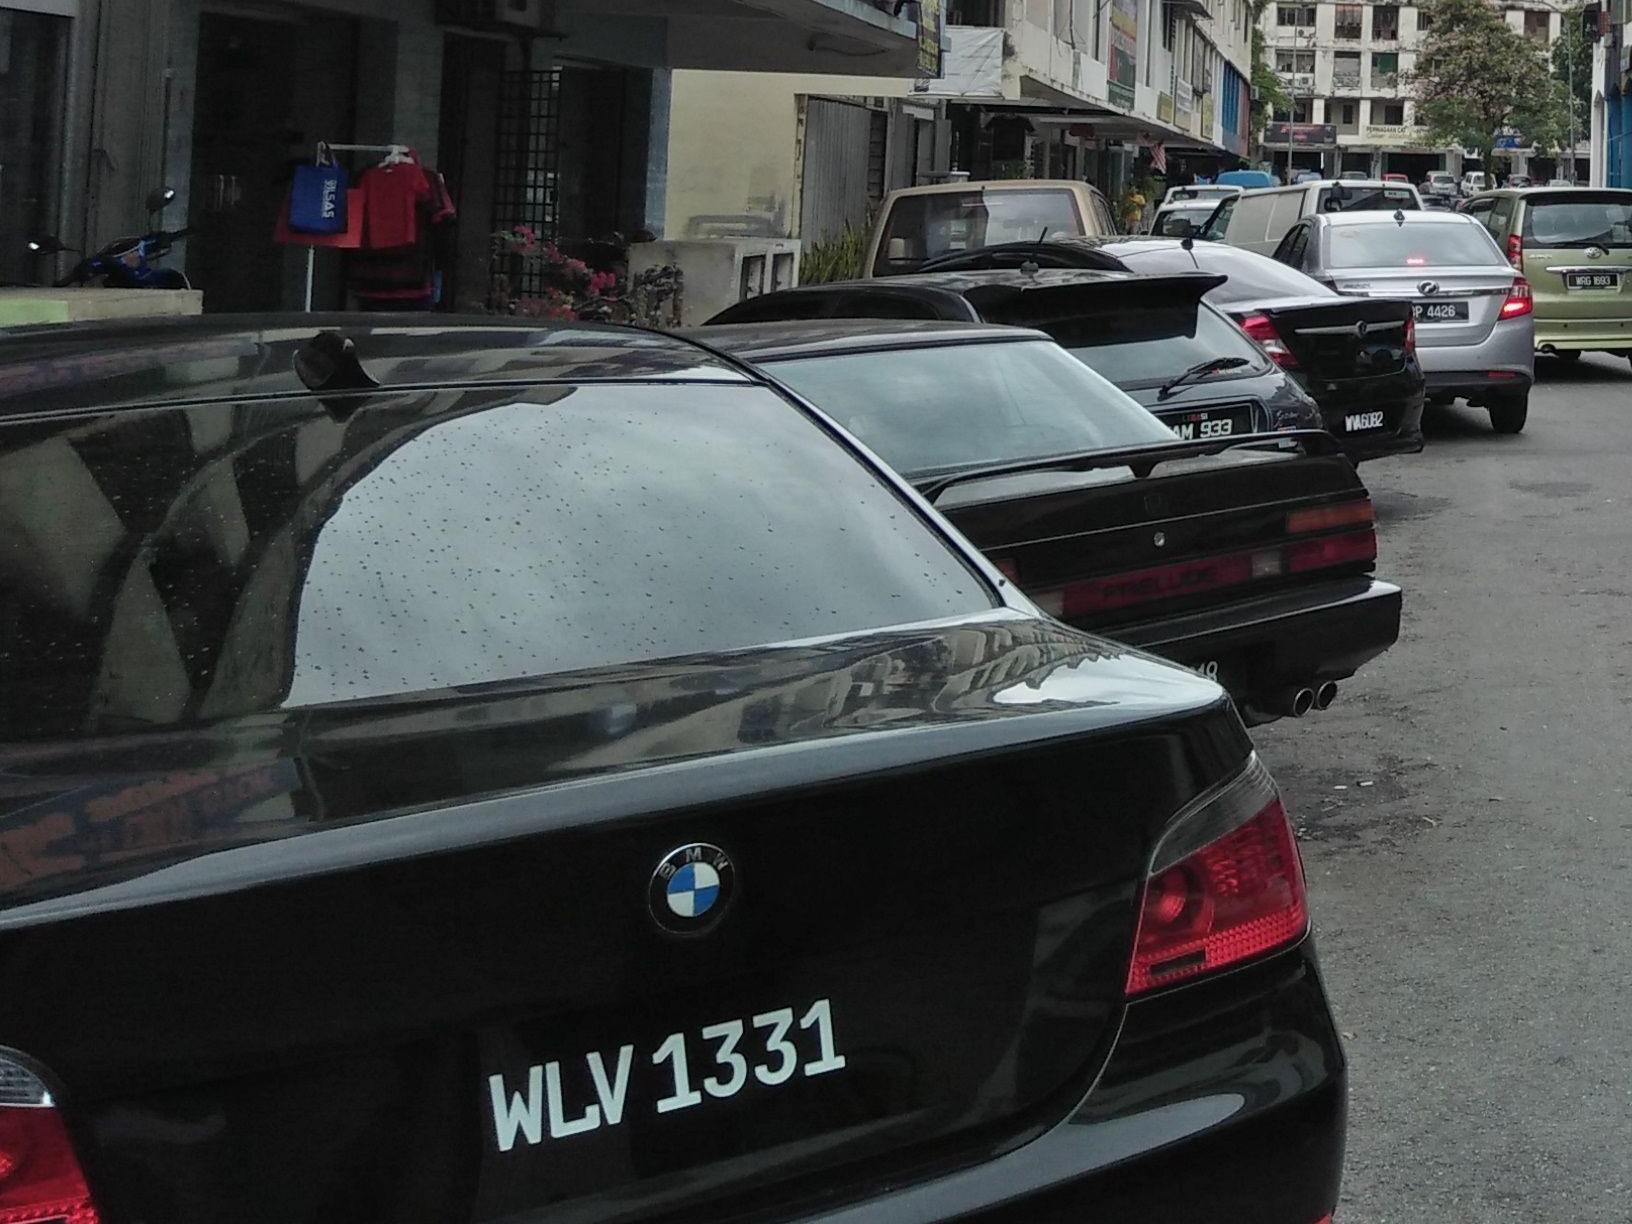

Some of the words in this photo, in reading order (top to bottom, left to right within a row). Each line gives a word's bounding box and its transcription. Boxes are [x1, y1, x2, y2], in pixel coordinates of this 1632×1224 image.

[1427, 305, 1456, 317] 4426
[1168, 423, 1194, 441] AM
[1200, 419, 1232, 438] 933
[659, 847, 729, 878] BMW
[488, 1043, 634, 1152] WLV
[651, 997, 847, 1114] 1331
